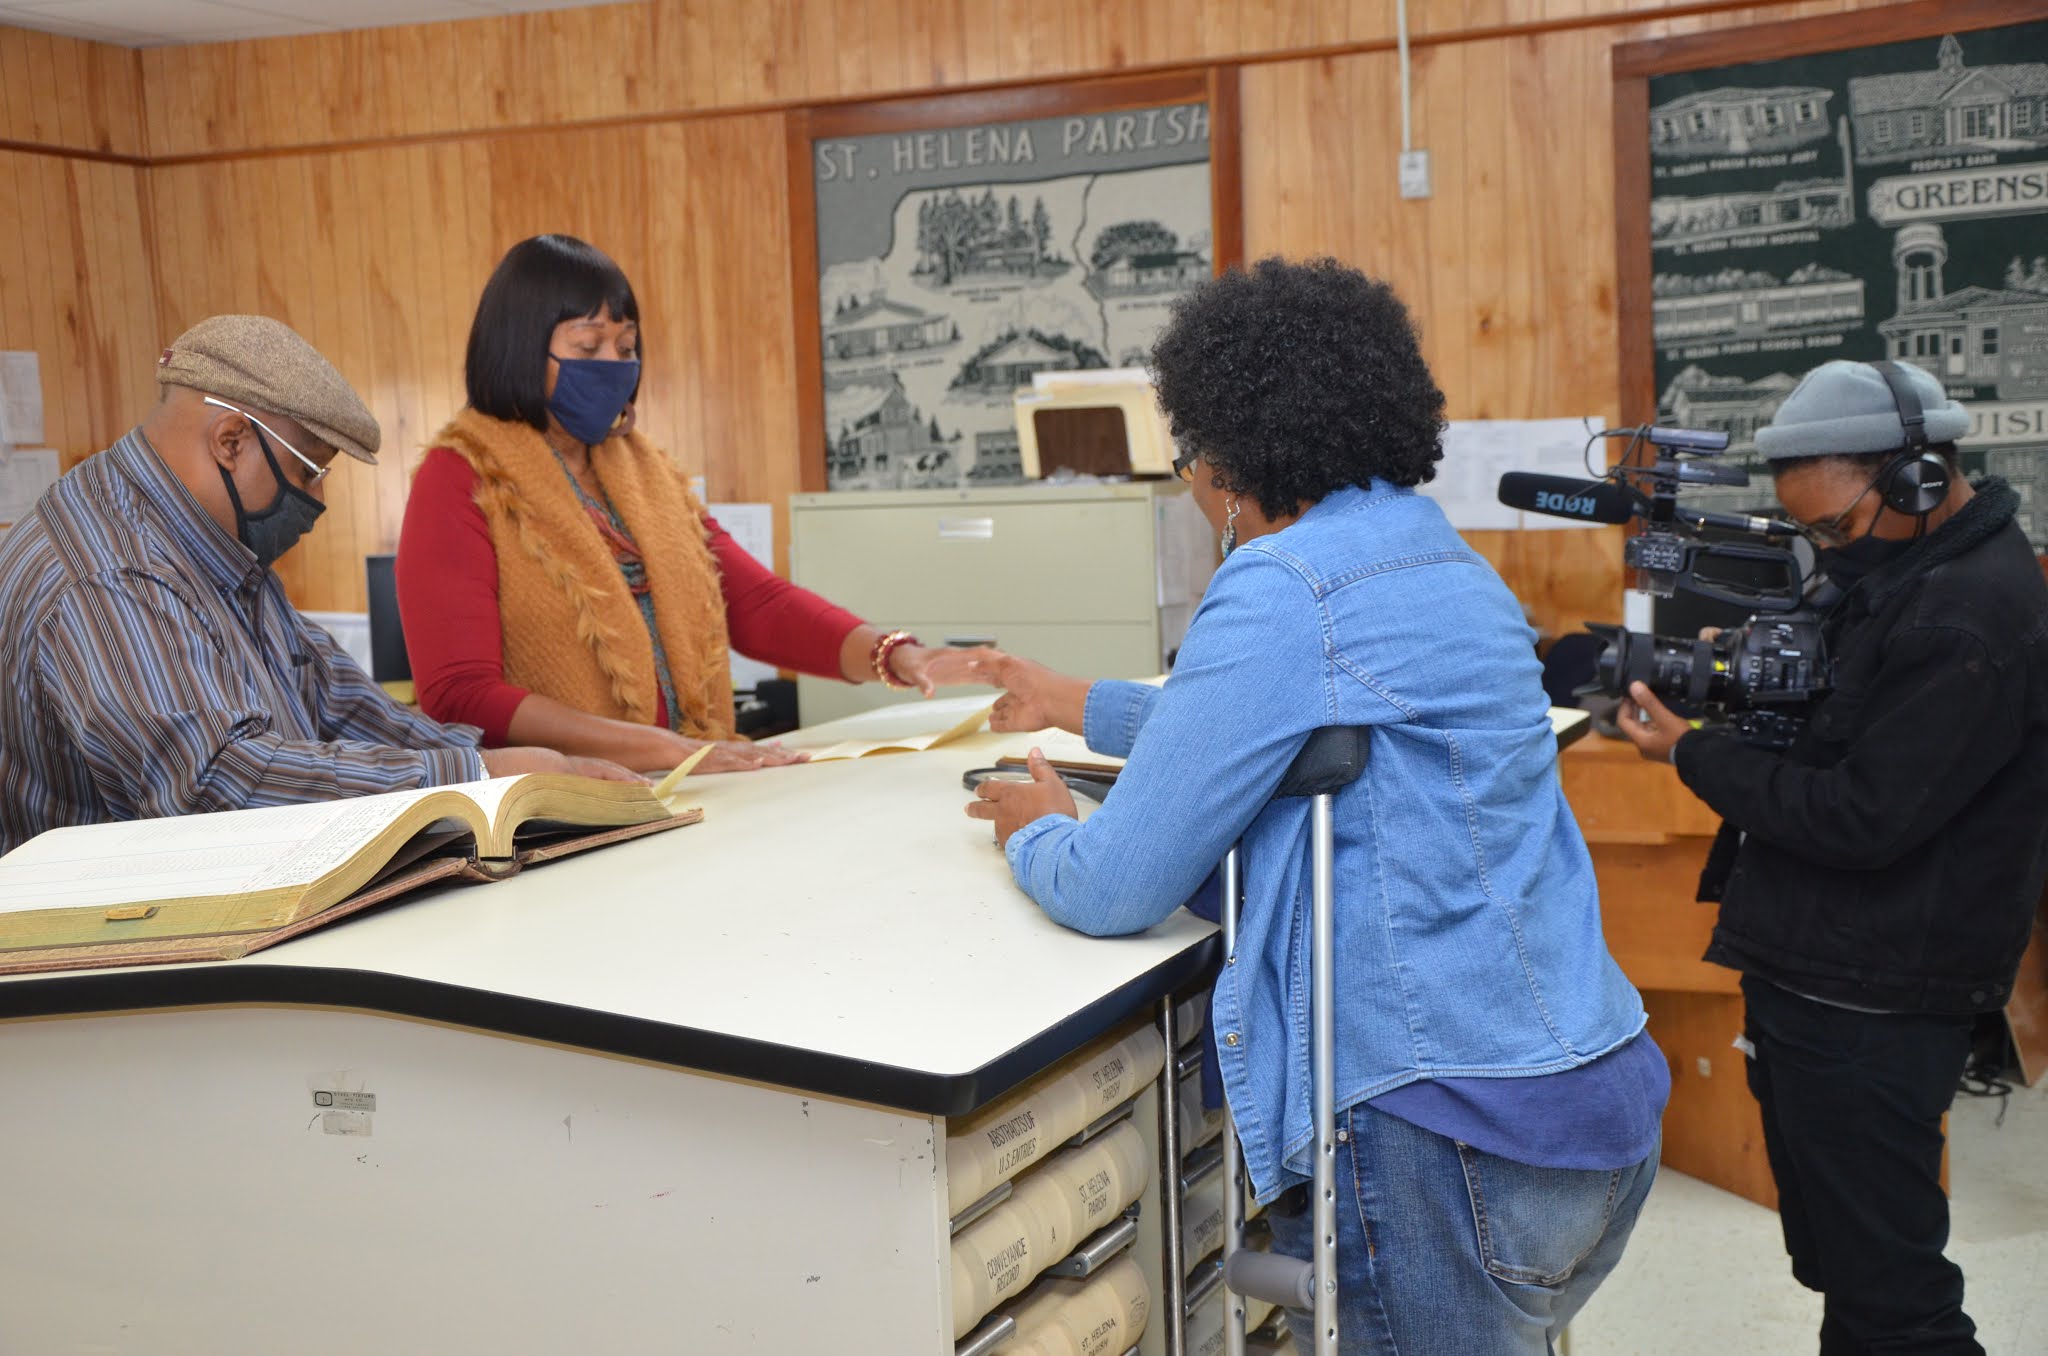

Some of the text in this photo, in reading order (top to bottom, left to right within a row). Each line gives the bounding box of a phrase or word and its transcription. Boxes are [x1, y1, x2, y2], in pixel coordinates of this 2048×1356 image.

[817, 105, 1209, 181] ST. HELENA PARISH
[1896, 175, 2048, 210] GREENS
[1102, 1057, 1125, 1083] HELENA
[1102, 1080, 1121, 1104] PARISH
[987, 1110, 1036, 1149] ABSTRACTS OF
[1087, 1170, 1111, 1197] HELENA
[1088, 1191, 1107, 1219] PARISH
[1051, 1227, 1057, 1245] A
[987, 1237, 1027, 1279] CONVEYANCE
[996, 1264, 1020, 1295] RECORD
[1081, 1317, 1116, 1351] ST. HELENA
